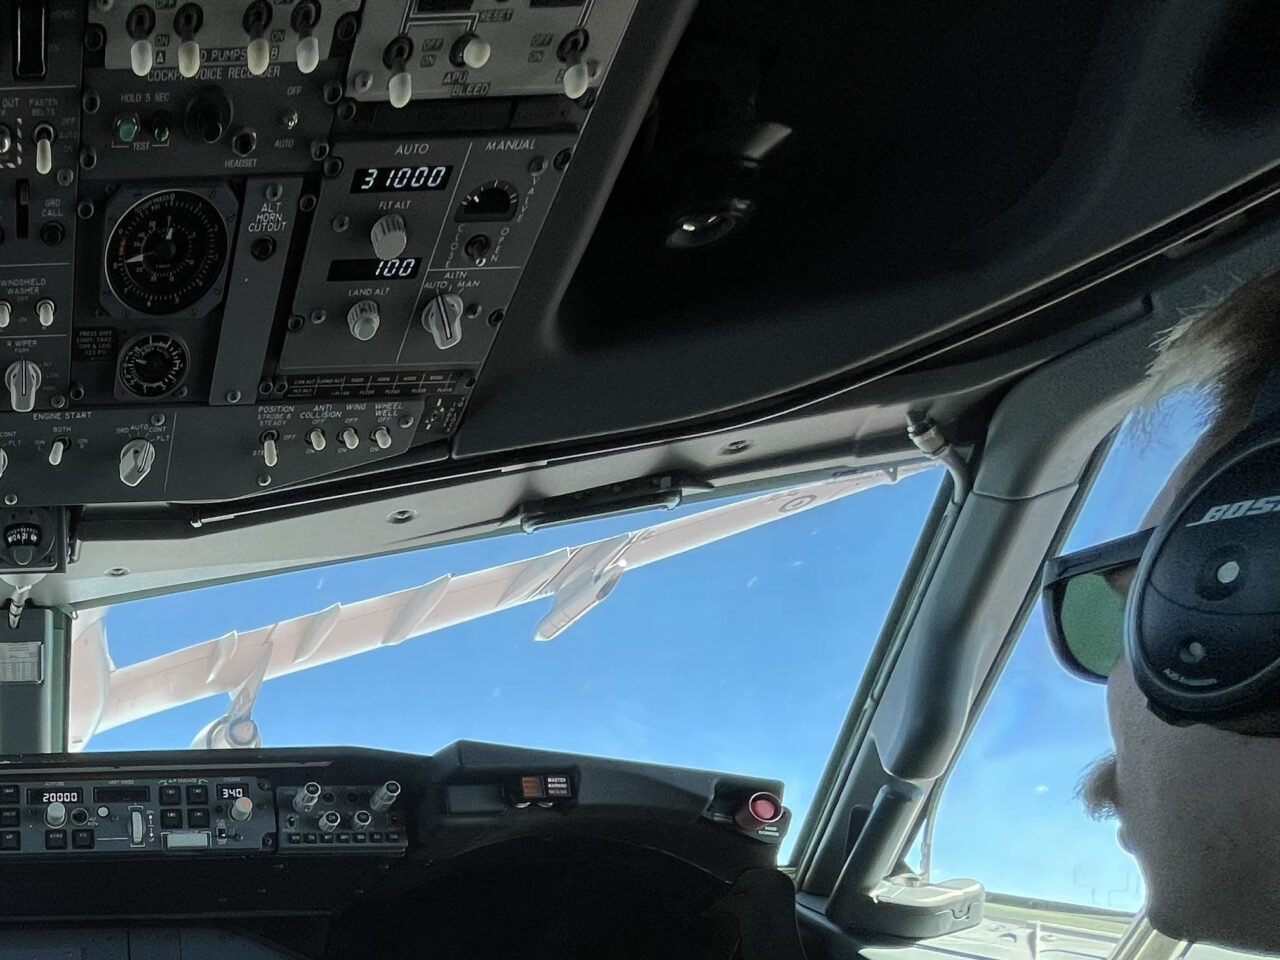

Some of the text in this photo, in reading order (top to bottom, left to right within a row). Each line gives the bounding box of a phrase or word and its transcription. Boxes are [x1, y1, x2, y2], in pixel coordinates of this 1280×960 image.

[480, 10, 513, 21] RESET
[156, 36, 169, 46] ON
[271, 31, 286, 42] ON
[156, 53, 165, 64] A
[211, 48, 247, 61] PUMPS
[444, 72, 468, 84] APU
[287, 87, 303, 97] OFF
[451, 83, 489, 96] BLEED
[120, 93, 142, 103] HOLD
[154, 92, 170, 102] SEC
[3, 98, 19, 108] OUT
[132, 142, 151, 151] TEST
[274, 139, 295, 149] AUTO
[395, 143, 430, 155] AUTO
[485, 139, 536, 151] MANUAL
[224, 159, 258, 169] HEADSET
[44, 199, 61, 208] GRD
[260, 203, 280, 214] ALT
[378, 200, 410, 210] FLT ALT
[41, 208, 64, 217] CALL
[256, 213, 283, 222] HORN
[248, 221, 289, 232] CUTOUT
[375, 258, 415, 277] 100
[444, 271, 467, 280] ALTN
[0, 278, 47, 288] WINDSHIELD
[424, 280, 448, 289] AUTO
[457, 280, 480, 288] MAN
[6, 286, 40, 296] WASHER
[348, 287, 391, 297] LAND ALT
[258, 405, 295, 414] POSITION
[346, 403, 367, 411] WING
[375, 402, 404, 410] WHEEL
[33, 411, 92, 421] ENGINE START
[300, 411, 342, 419] COLLISION
[375, 409, 398, 417] WELL
[130, 423, 148, 431] AUTO
[148, 426, 167, 434] CONT
[42, 793, 78, 802] 20000
[222, 788, 244, 798] 340
